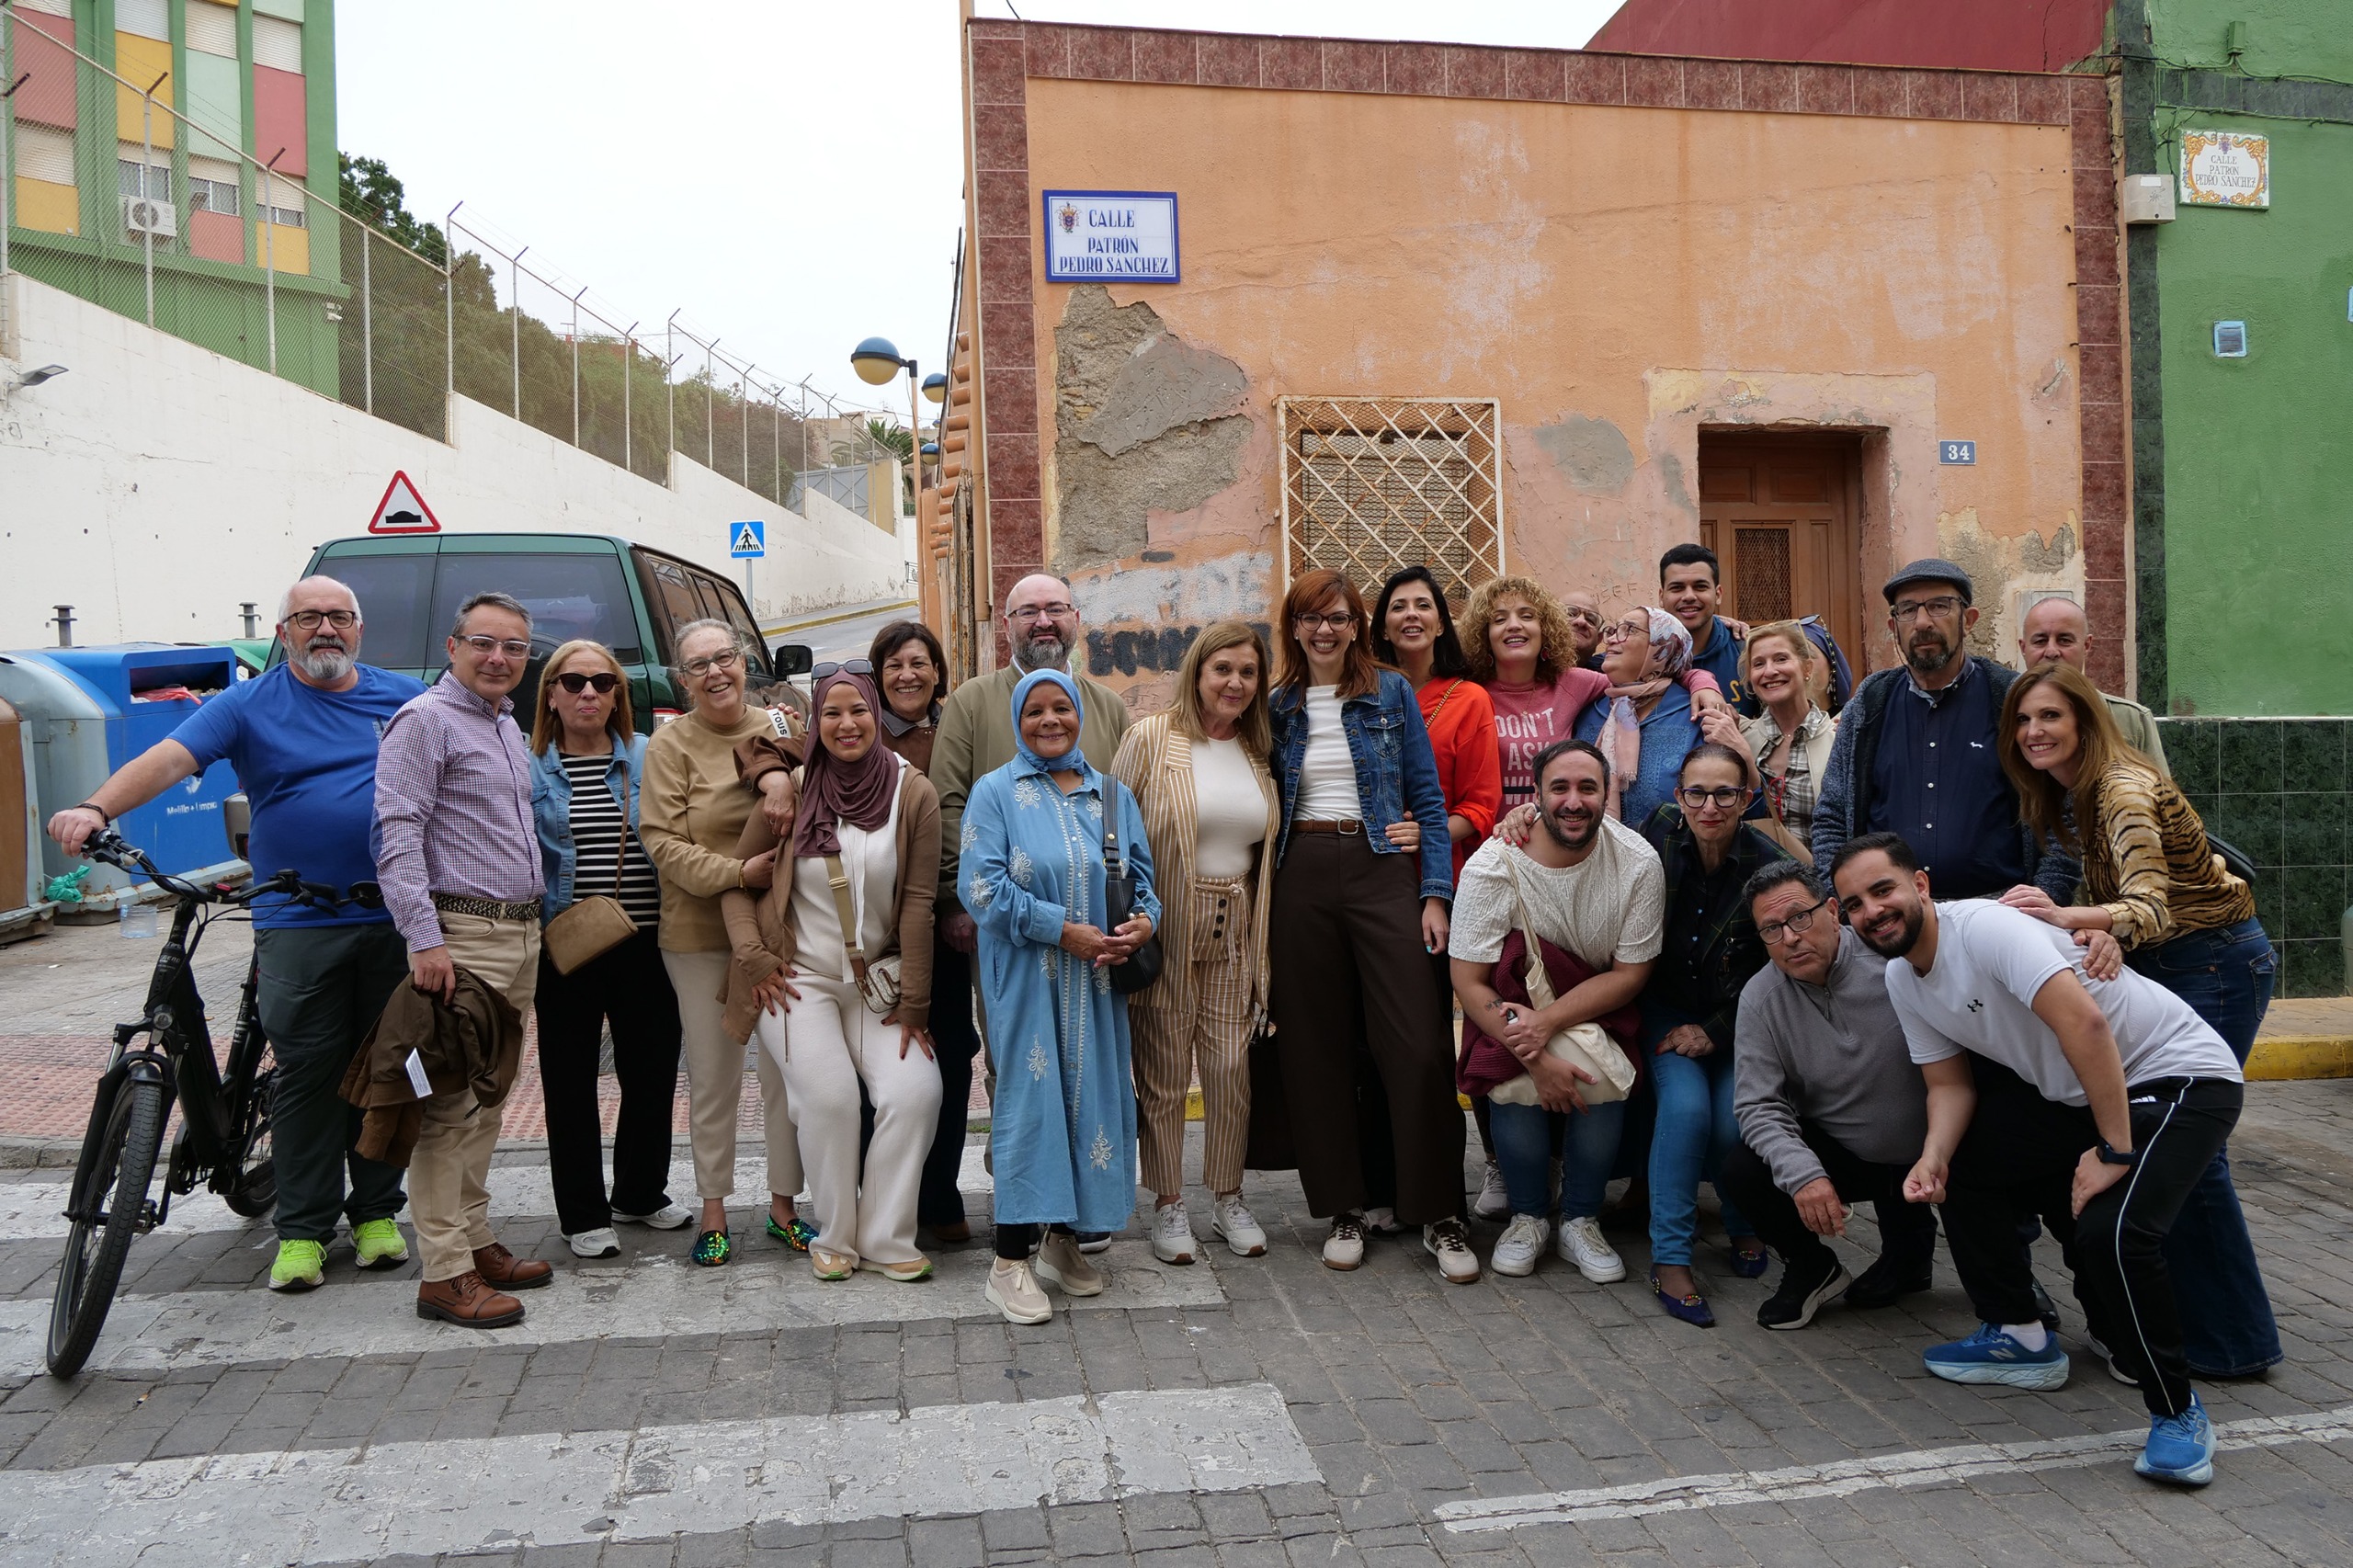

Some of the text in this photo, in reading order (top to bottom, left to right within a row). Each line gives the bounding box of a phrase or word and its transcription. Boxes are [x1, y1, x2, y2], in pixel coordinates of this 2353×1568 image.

[2211, 155, 2237, 165] CALLE
[2195, 174, 2256, 187] PEDRO SANCHEZ
[1088, 209, 1135, 228] CALLE
[1087, 234, 1139, 254] PATRÓN
[1060, 254, 1168, 274] PEDRO SÁNCHEZ
[1948, 444, 1971, 460] 34
[772, 711, 788, 736] TOUS
[1494, 707, 1555, 739] DON'T
[1507, 741, 1550, 771] AS
